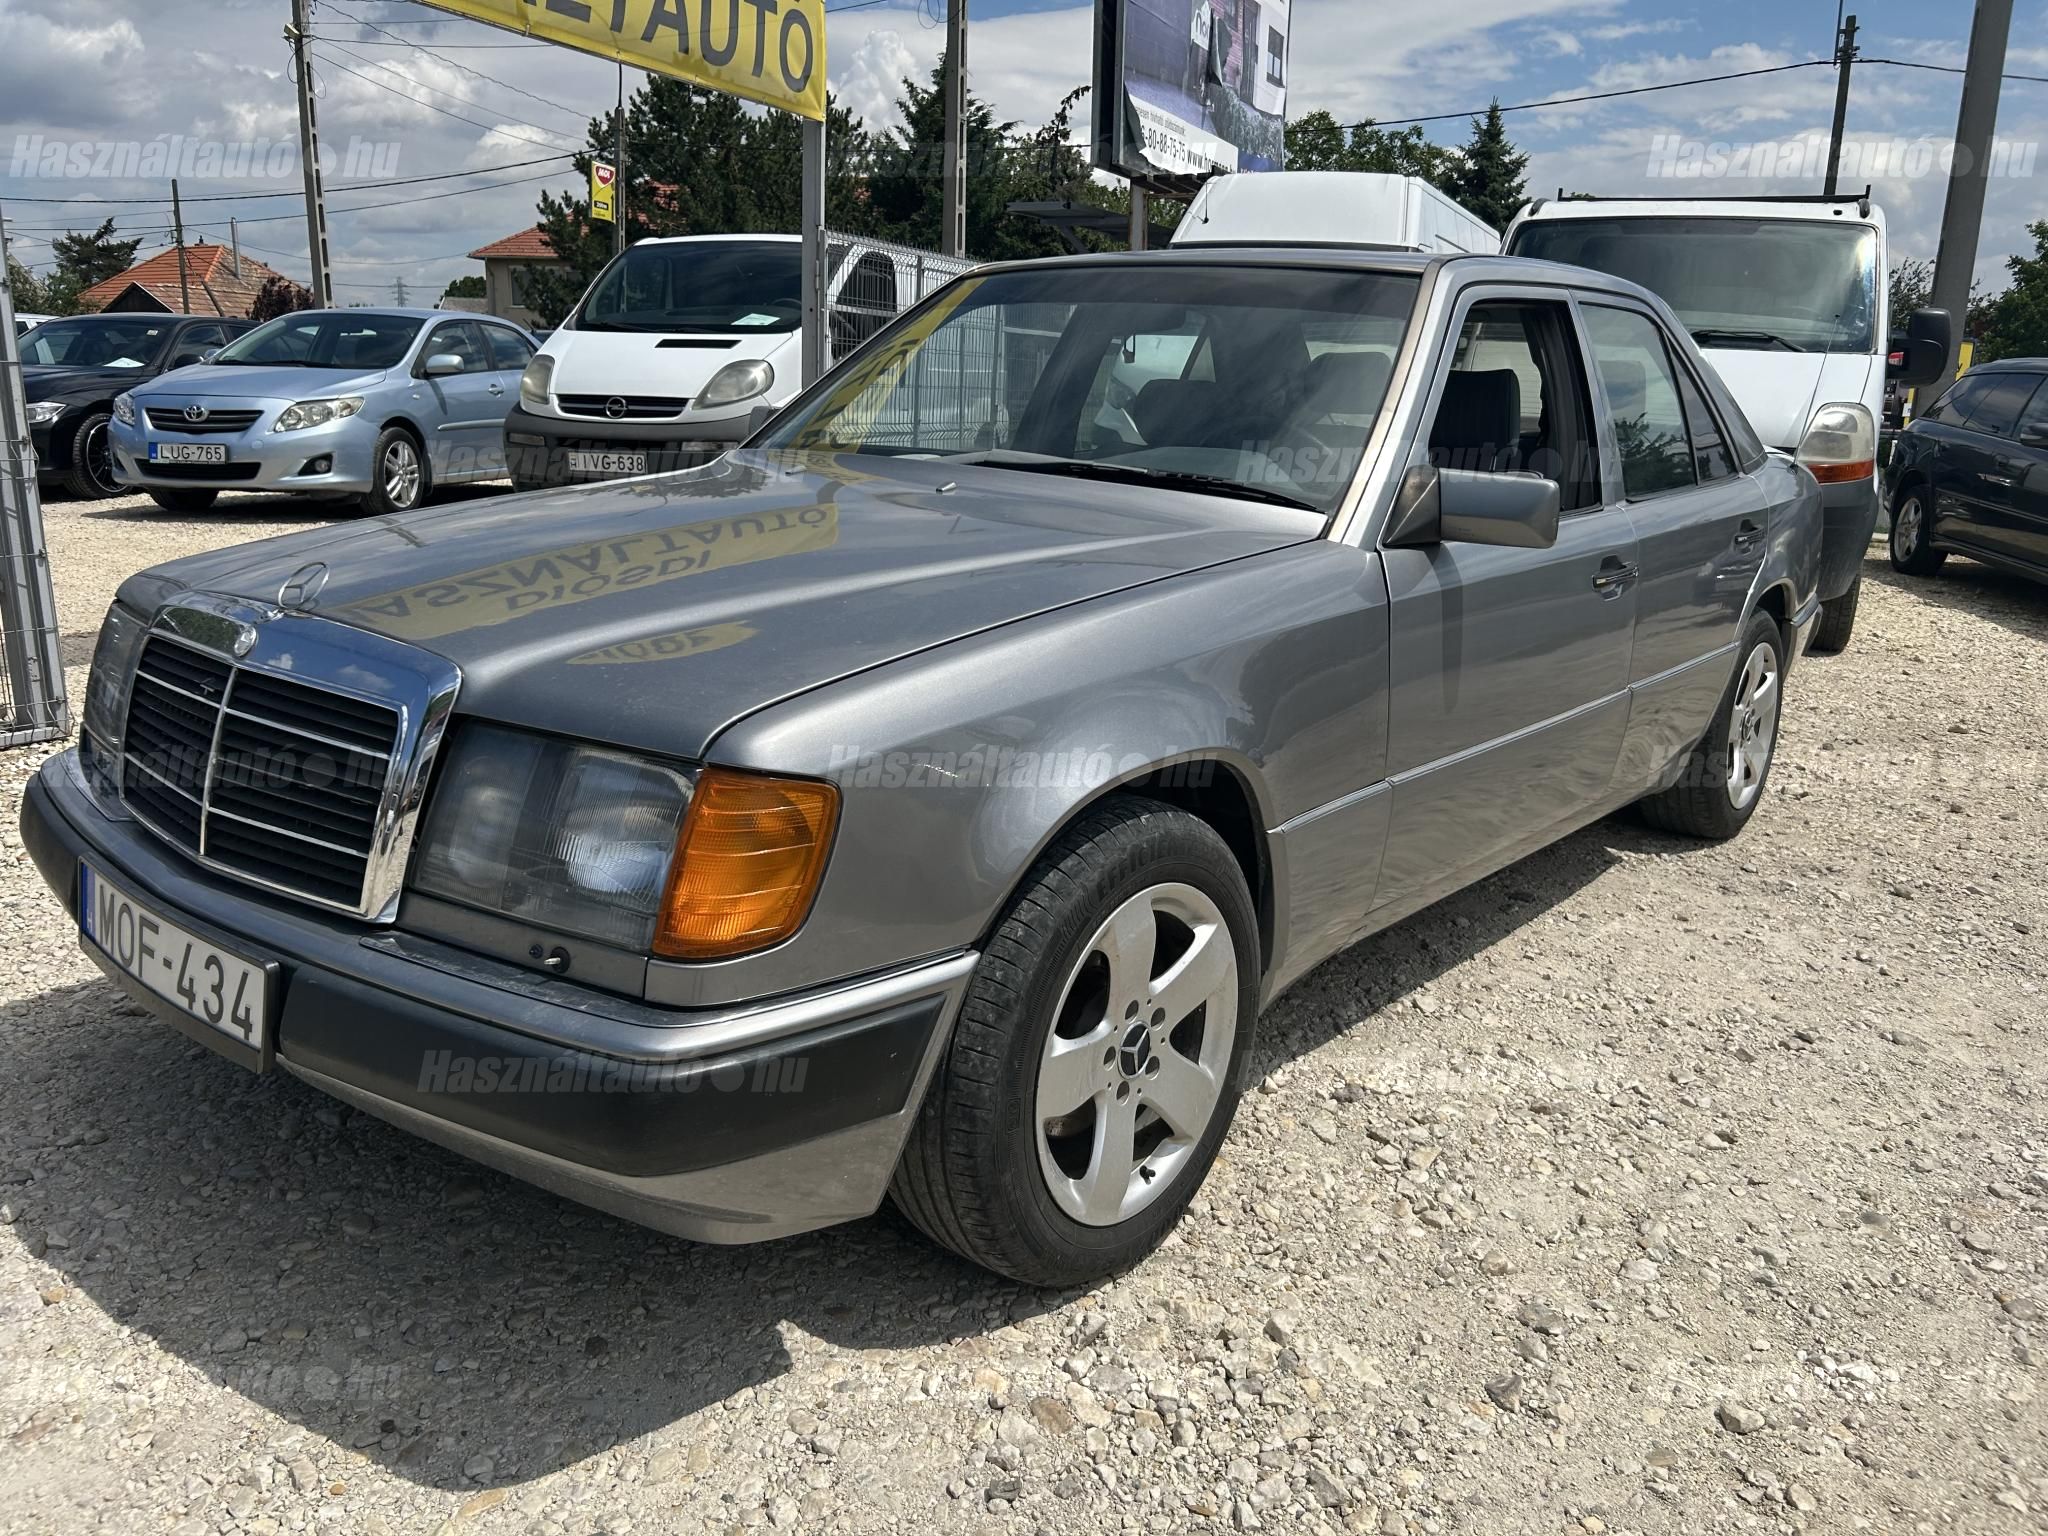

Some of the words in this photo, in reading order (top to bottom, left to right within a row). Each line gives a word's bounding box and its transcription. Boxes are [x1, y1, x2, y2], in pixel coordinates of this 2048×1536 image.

[160, 445, 222, 460] LUG-765
[583, 454, 644, 471] IVG-638
[100, 884, 253, 1041] MOF-434
